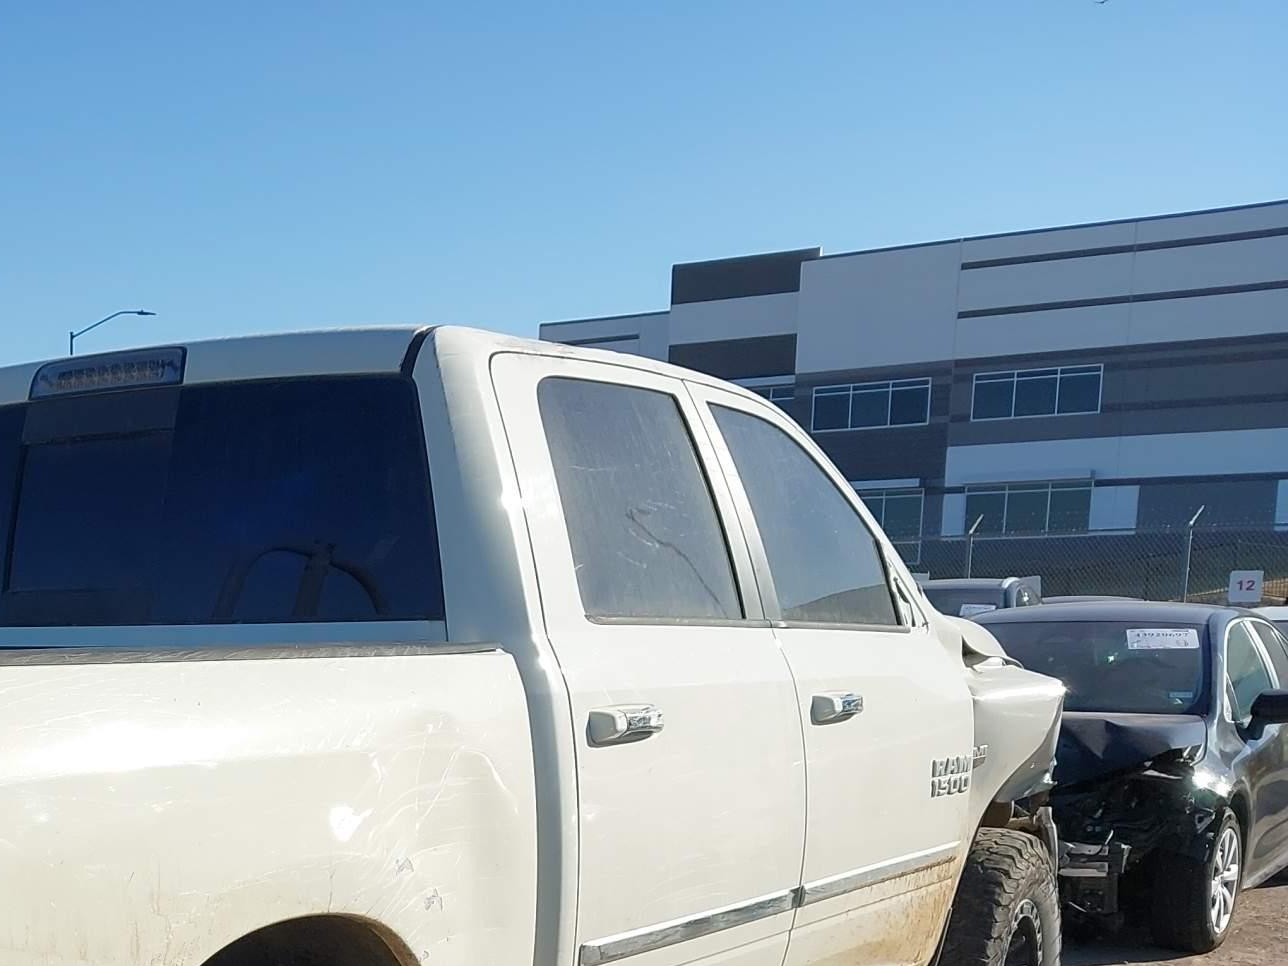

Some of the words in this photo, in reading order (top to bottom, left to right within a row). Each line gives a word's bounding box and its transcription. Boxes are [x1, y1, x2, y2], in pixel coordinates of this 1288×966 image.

[1236, 579, 1256, 592] 12
[931, 755, 971, 777] RAM
[930, 775, 969, 798] 1500
